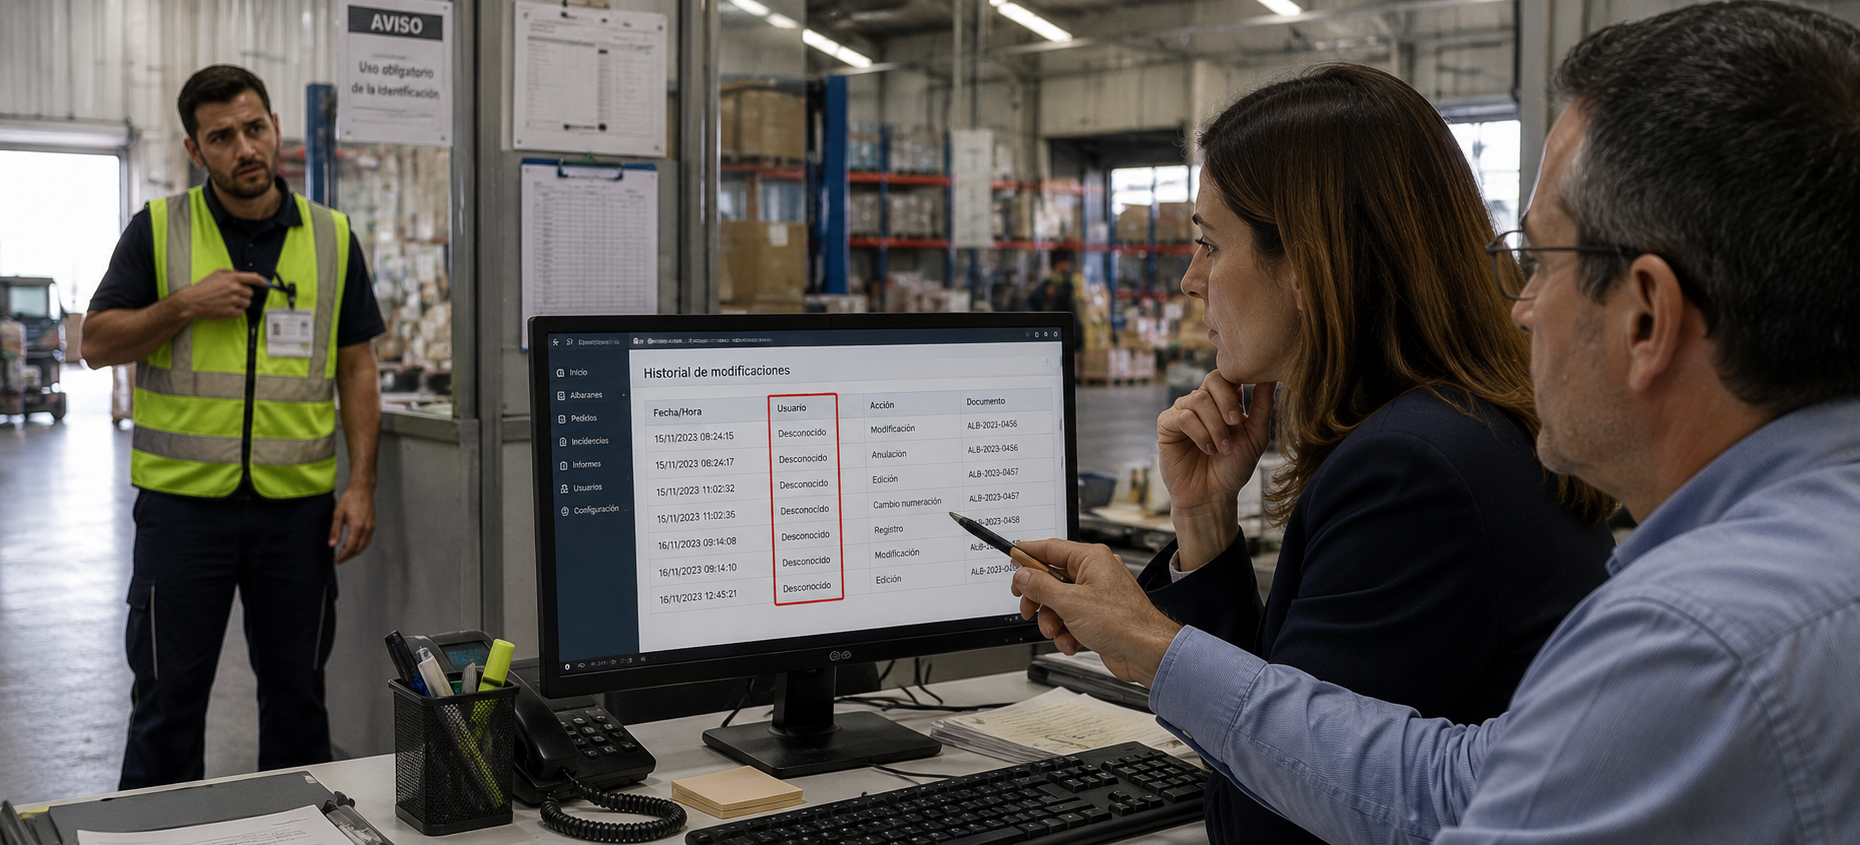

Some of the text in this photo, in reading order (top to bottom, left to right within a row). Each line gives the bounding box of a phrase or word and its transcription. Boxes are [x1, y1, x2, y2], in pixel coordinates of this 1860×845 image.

[371, 14, 423, 34] AVISO
[359, 61, 379, 74] Uso
[352, 83, 363, 94] de
[367, 83, 375, 94] la
[570, 368, 587, 376] Inicio
[644, 365, 790, 379] Historial de modificaciones
[571, 391, 602, 399] Albaranes
[870, 401, 894, 410] Acción
[967, 398, 1005, 406] Documento
[654, 408, 702, 418] Fecha/Hora
[778, 405, 806, 413] Usuario
[571, 414, 597, 423] Pedidos
[779, 428, 826, 438] Desconocido
[871, 424, 915, 434] Modificación
[655, 433, 698, 444] 15/11/2023
[779, 454, 827, 464] Desconocido
[872, 450, 906, 459] Anulación
[573, 460, 601, 469] Informes
[656, 460, 698, 470] 15/11/2023
[780, 479, 828, 490] Desconocido
[873, 474, 898, 484] Edición
[574, 482, 602, 493] Usuarios
[657, 484, 734, 497] 15/11/2023 11:02:32
[874, 497, 941, 510] Cambio numeración
[574, 504, 619, 516] Configuración
[781, 505, 829, 516] Desconocido
[658, 513, 700, 524] 15/11/2023
[782, 530, 830, 542] Desconocido
[875, 526, 903, 536] Registro
[658, 537, 736, 551] 16/11/2023 09:14:08
[875, 548, 919, 560] Modificación
[783, 556, 830, 568] Desconocido
[659, 563, 737, 578] 16/11/2023 09:14:10
[876, 575, 901, 585] Edición
[783, 581, 831, 594] Desconocido
[660, 590, 736, 605] 16/11/2023 12:45:21
